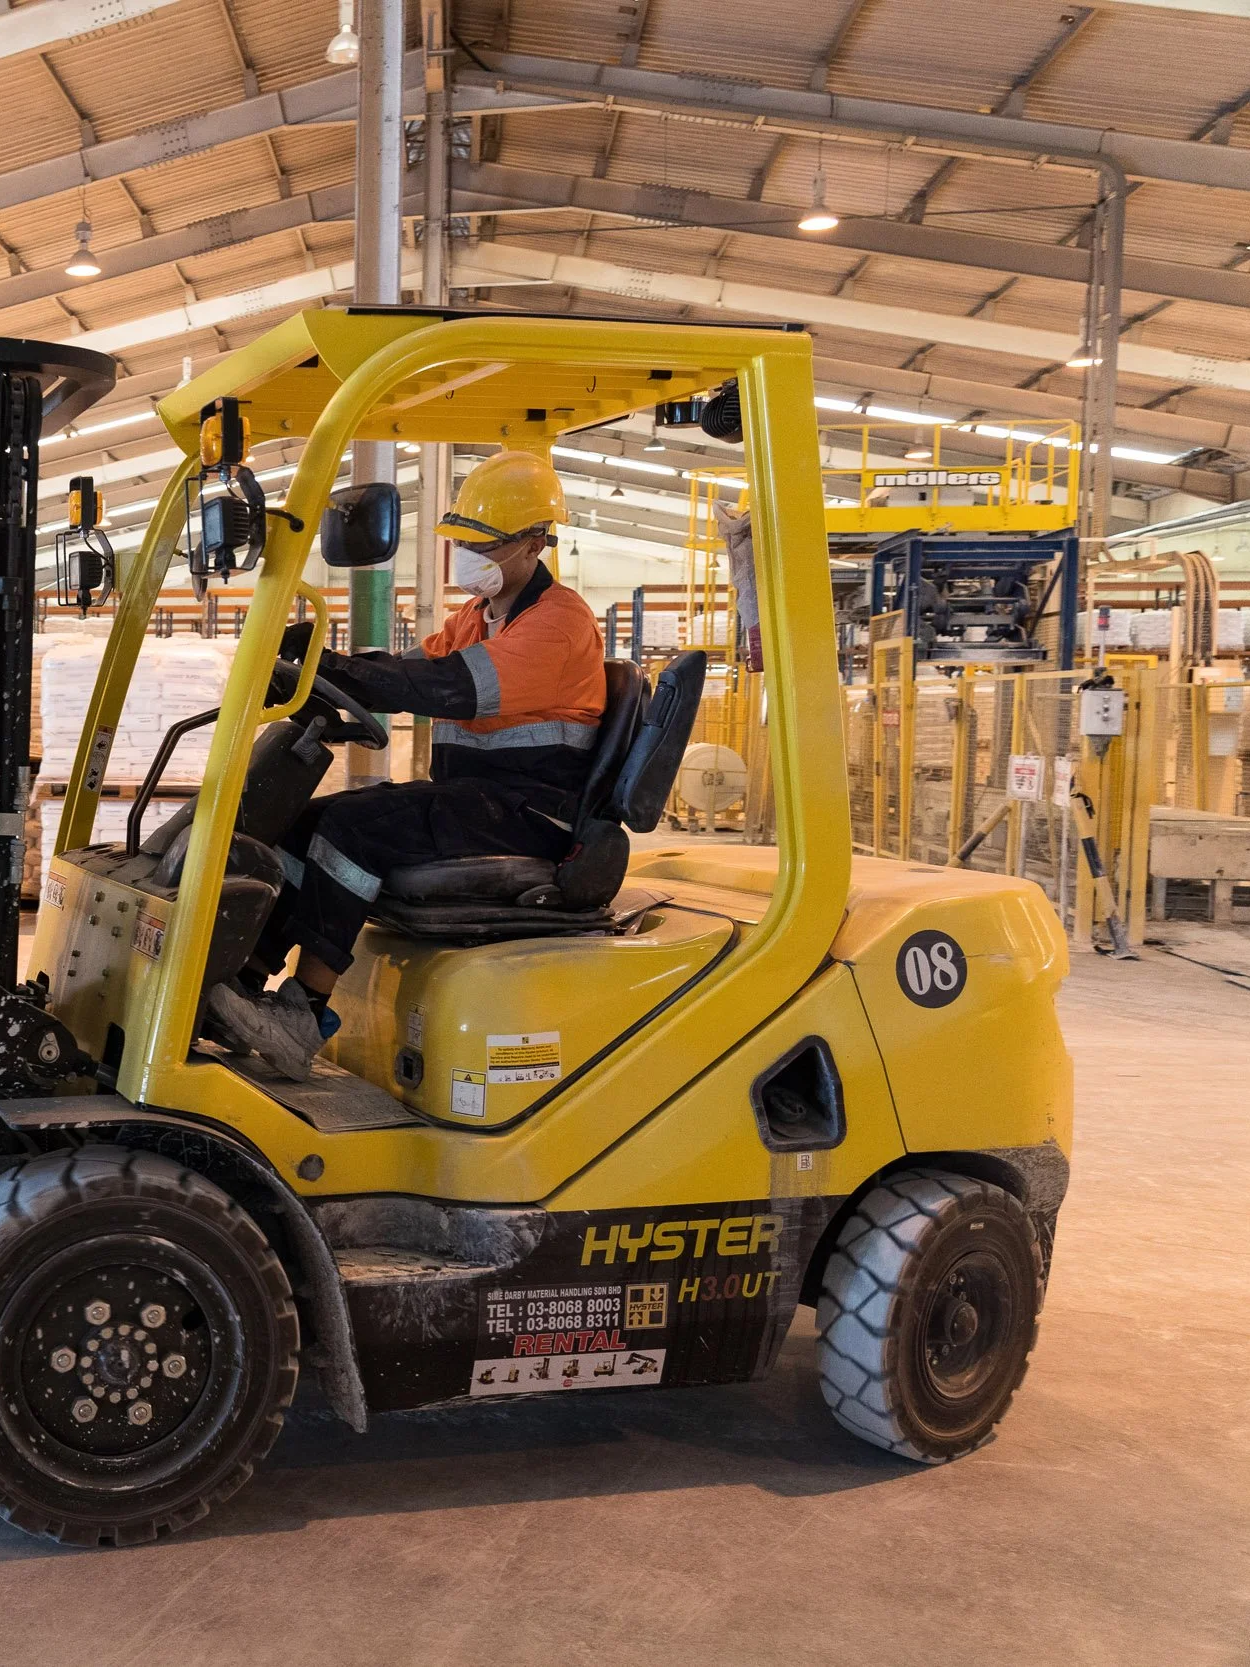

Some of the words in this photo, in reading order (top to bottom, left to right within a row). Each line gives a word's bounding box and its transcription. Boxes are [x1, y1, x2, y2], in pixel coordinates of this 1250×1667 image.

[874, 470, 1001, 487] möllers
[904, 941, 959, 996] 08
[580, 1214, 784, 1266] HYSTER
[487, 1291, 503, 1301] SIME
[504, 1289, 526, 1299] DARBY
[527, 1288, 559, 1299] MATERIAL
[559, 1286, 593, 1297] HANDLING
[593, 1286, 607, 1296] SDN
[608, 1285, 622, 1295] BHD
[487, 1304, 514, 1318] TEL
[526, 1301, 584, 1316] 03-8068
[586, 1297, 621, 1312] 8003
[629, 1302, 664, 1310] HYSTER
[486, 1319, 514, 1333] TEL
[526, 1316, 583, 1331] 03-8068
[585, 1313, 620, 1328] 8311
[513, 1329, 627, 1356] RENTAL
